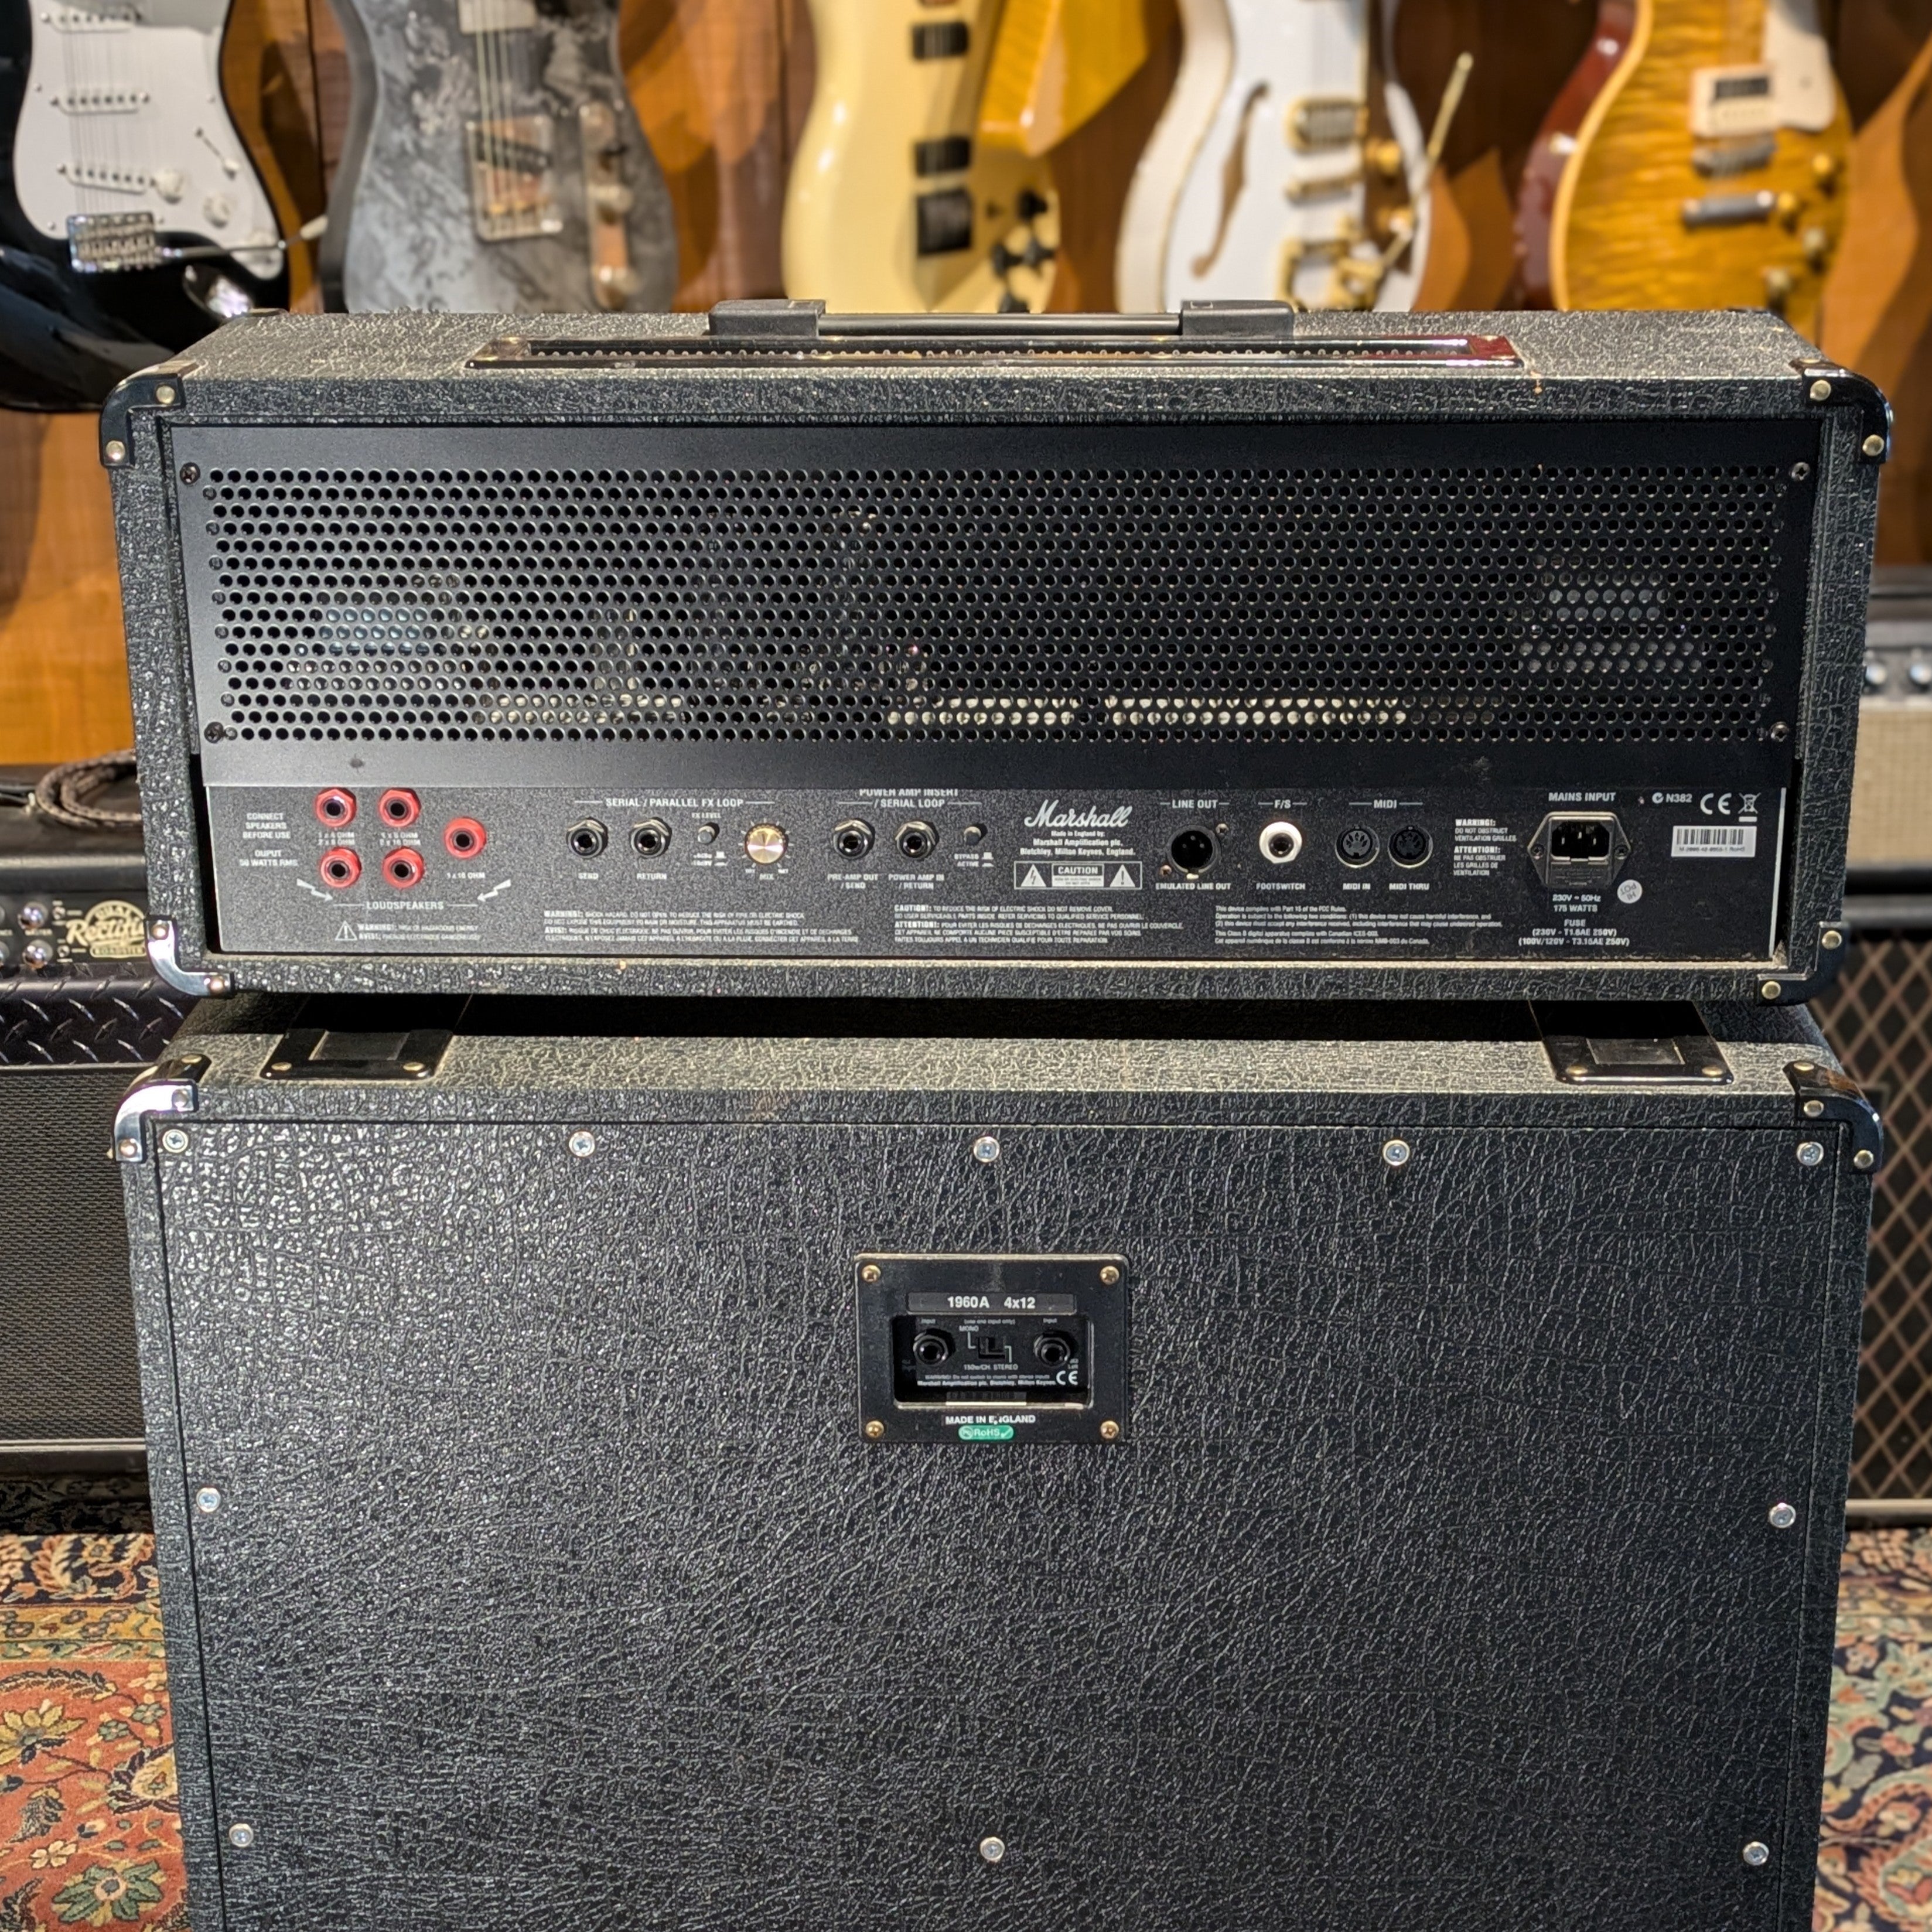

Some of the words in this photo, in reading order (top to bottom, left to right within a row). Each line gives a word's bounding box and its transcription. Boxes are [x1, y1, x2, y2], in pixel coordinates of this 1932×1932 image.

[1548, 792, 1582, 801] MAINS
[1585, 792, 1616, 801] INPUT
[1666, 793, 1692, 803] N382
[606, 798, 640, 807] SERIAL
[650, 798, 698, 807] PARALLEL
[701, 798, 714, 807] FX
[717, 798, 743, 807] LOOP
[880, 799, 915, 808] SERIAL
[918, 799, 945, 808] LOOP
[1172, 800, 1194, 808] LINE
[1197, 800, 1218, 808] OUT
[1274, 800, 1291, 809] F/S
[1374, 799, 1397, 808] MIDI
[1024, 799, 1133, 827] Marshall
[1054, 848, 1076, 856] Milton
[1552, 894, 1572, 902] 230V
[366, 901, 444, 910] LOUDSPEAKERS
[1532, 928, 1556, 937] (230V
[947, 1296, 990, 1309] 1960A
[1004, 1296, 1036, 1309] 4x12
[945, 1416, 974, 1425] MADE
[974, 1428, 1000, 1436] RoHS
